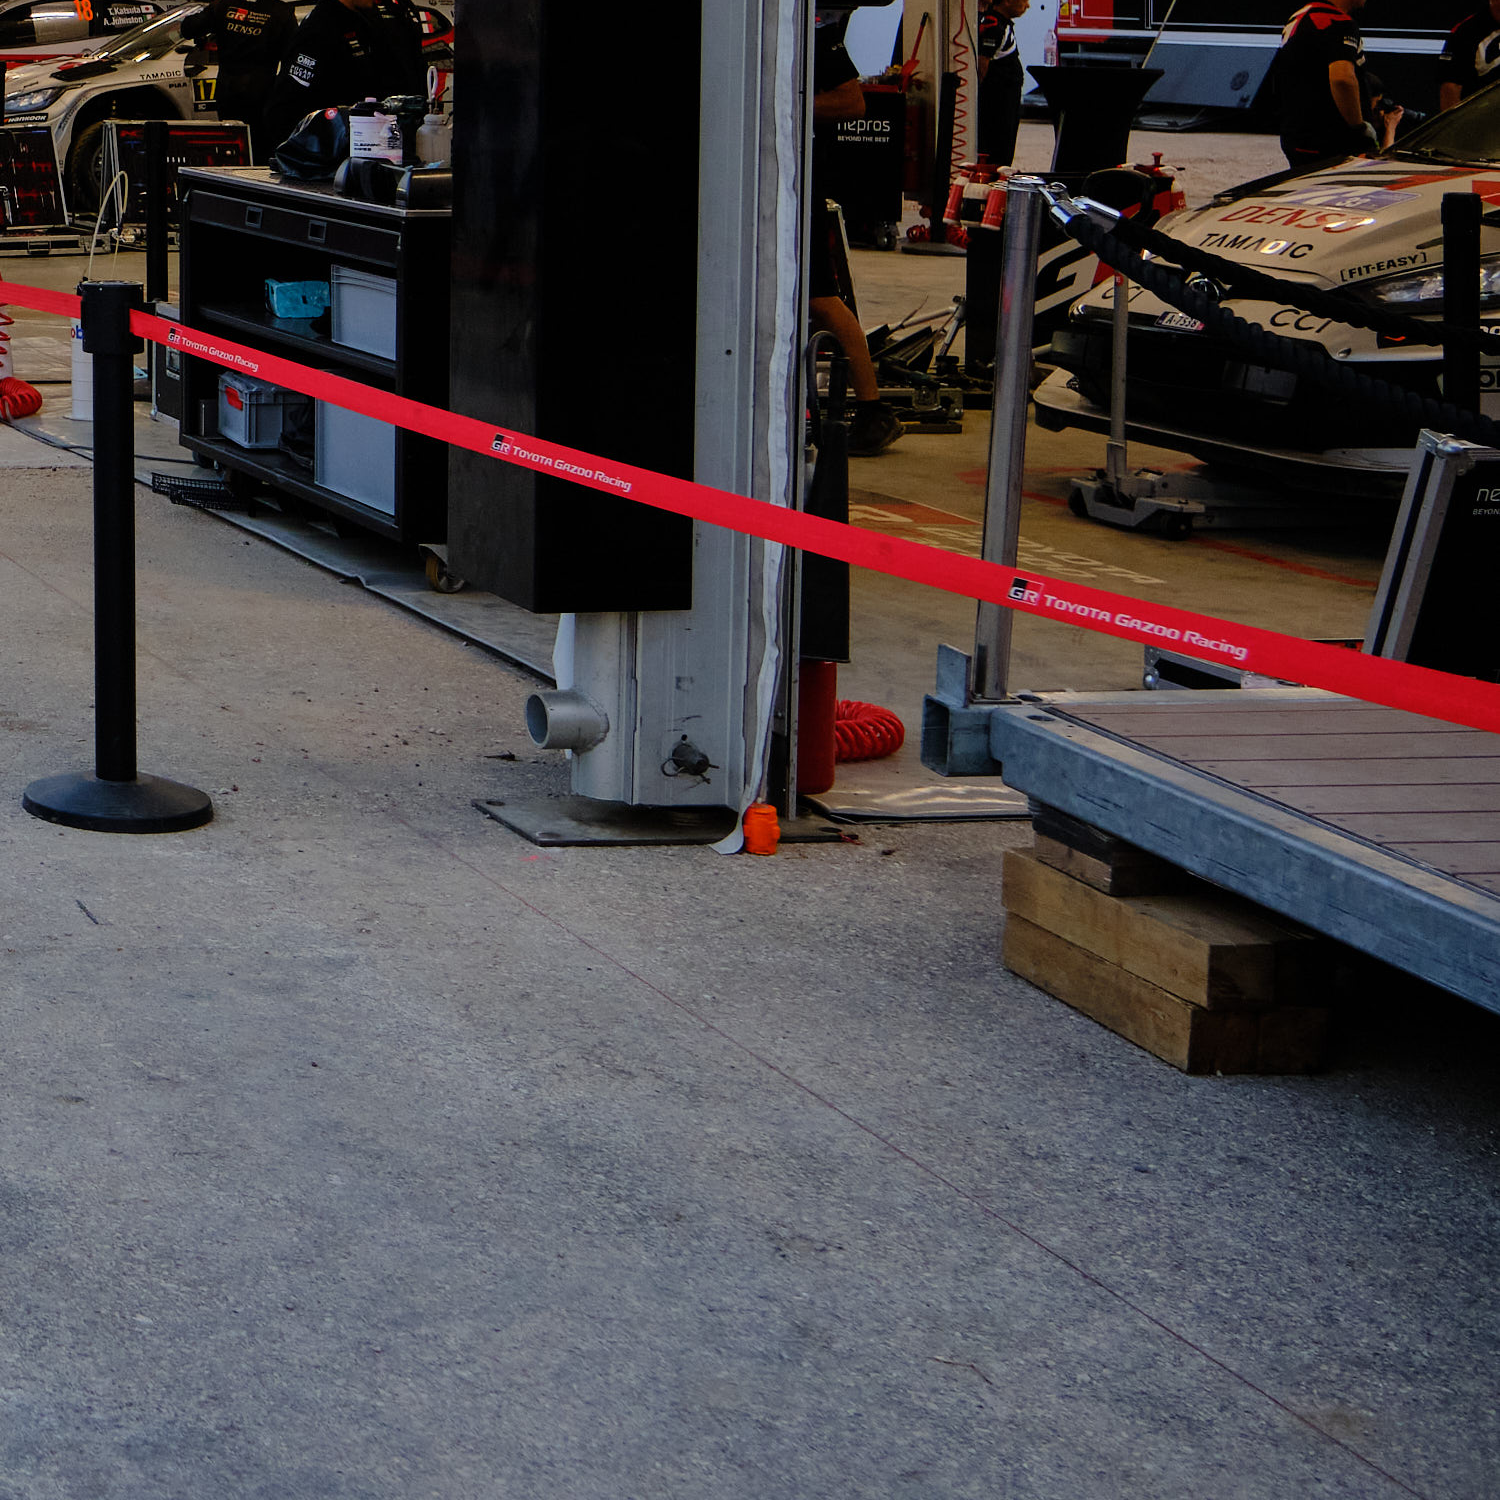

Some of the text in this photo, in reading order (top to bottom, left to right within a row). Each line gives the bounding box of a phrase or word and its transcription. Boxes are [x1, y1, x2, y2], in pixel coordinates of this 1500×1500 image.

[227, 23, 263, 37] DENSO
[297, 55, 317, 67] OMP
[140, 70, 182, 81] TAMADIC
[197, 79, 217, 100] 17
[1218, 206, 1377, 234] DENSO
[1199, 233, 1314, 259] TAMADIC
[168, 332, 259, 373] GR TOYOTA GAZOO Racing
[492, 439, 632, 493] GR TOYOTA GAZOO Racing
[1009, 586, 1249, 662] GR TOYOTA GAZOO Racing
